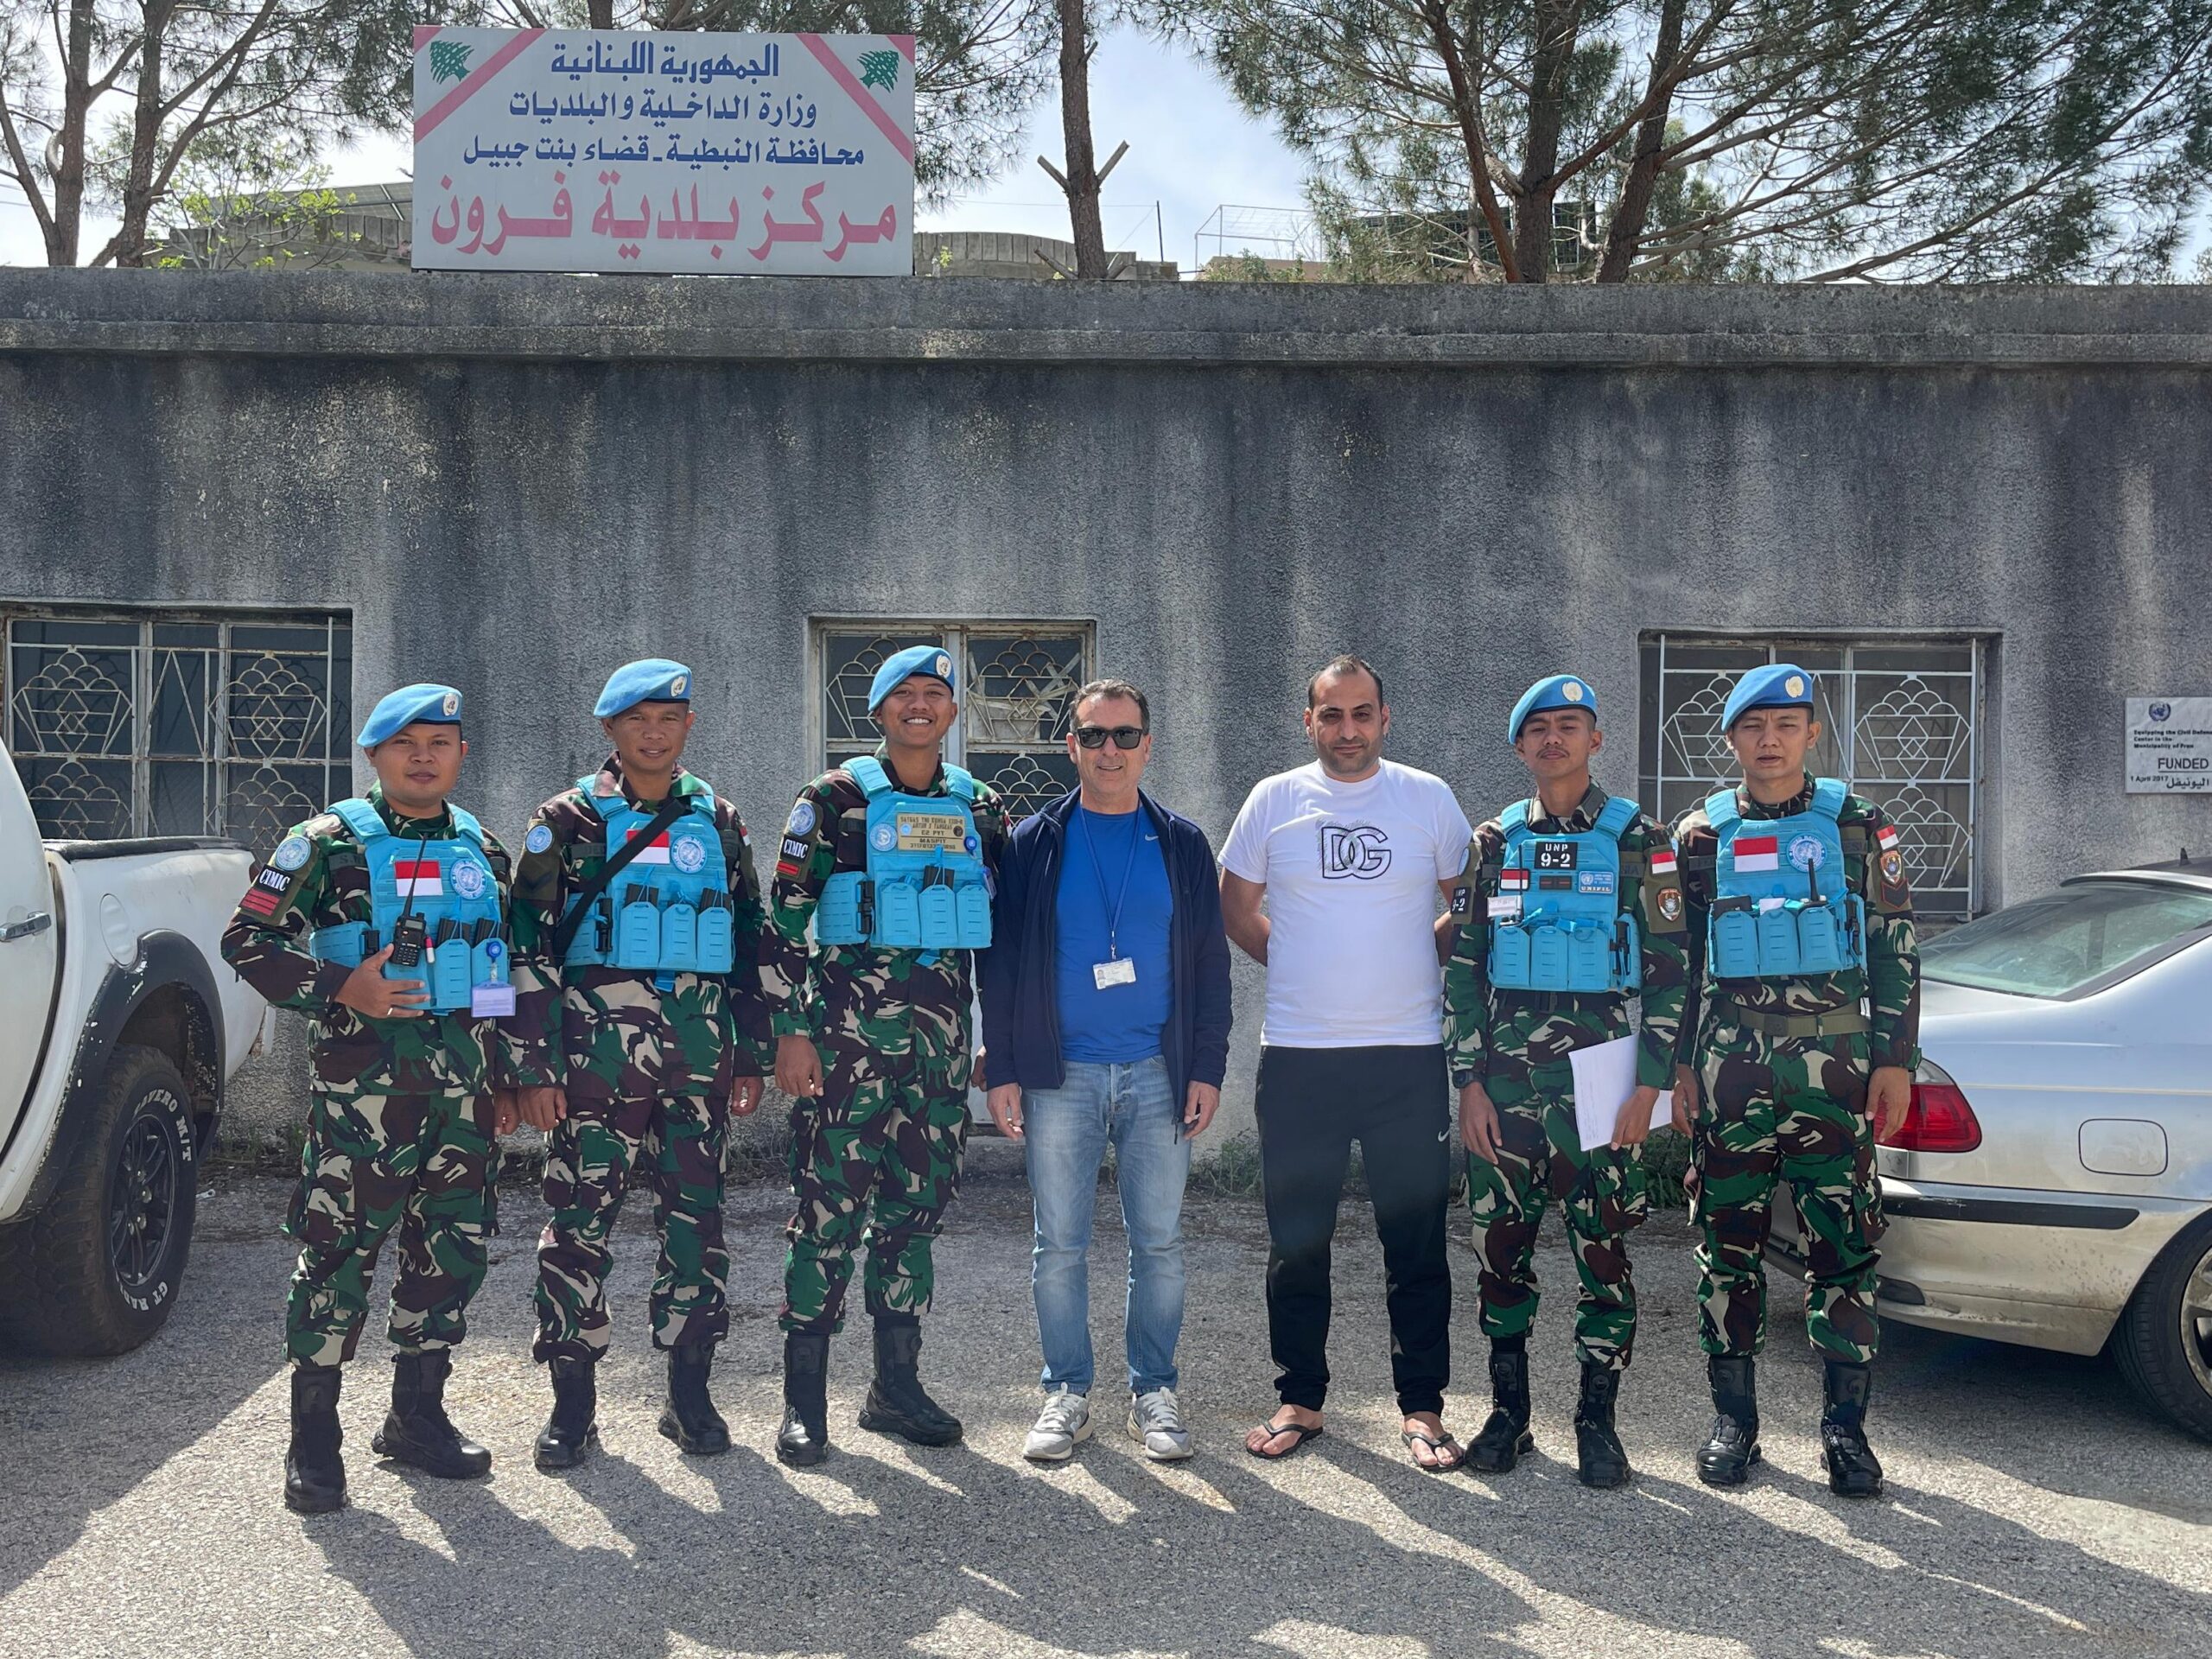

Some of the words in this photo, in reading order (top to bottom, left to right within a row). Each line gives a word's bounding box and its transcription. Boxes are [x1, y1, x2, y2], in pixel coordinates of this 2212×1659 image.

[550, 40, 655, 82] اللبنانية
[660, 42, 779, 85] الجمهورية
[509, 91, 634, 125] والبلديات
[639, 87, 750, 127] الداخلية
[758, 91, 817, 129] وزارة
[462, 134, 530, 168] جبيل
[533, 137, 577, 168] بنت
[582, 134, 650, 162] قضاء
[665, 132, 760, 171] النبطية
[765, 136, 865, 166] محافظة
[431, 169, 574, 257] فرون
[591, 169, 738, 260] بلدية
[747, 180, 897, 262] مركز
[2158, 758, 2209, 769] FUNDED
[784, 838, 809, 859] CIMIC
[1321, 826, 1391, 880] DG
[1541, 852, 1571, 868] 9-2
[1545, 842, 1568, 852] UNP
[259, 868, 290, 892] CIMIC
